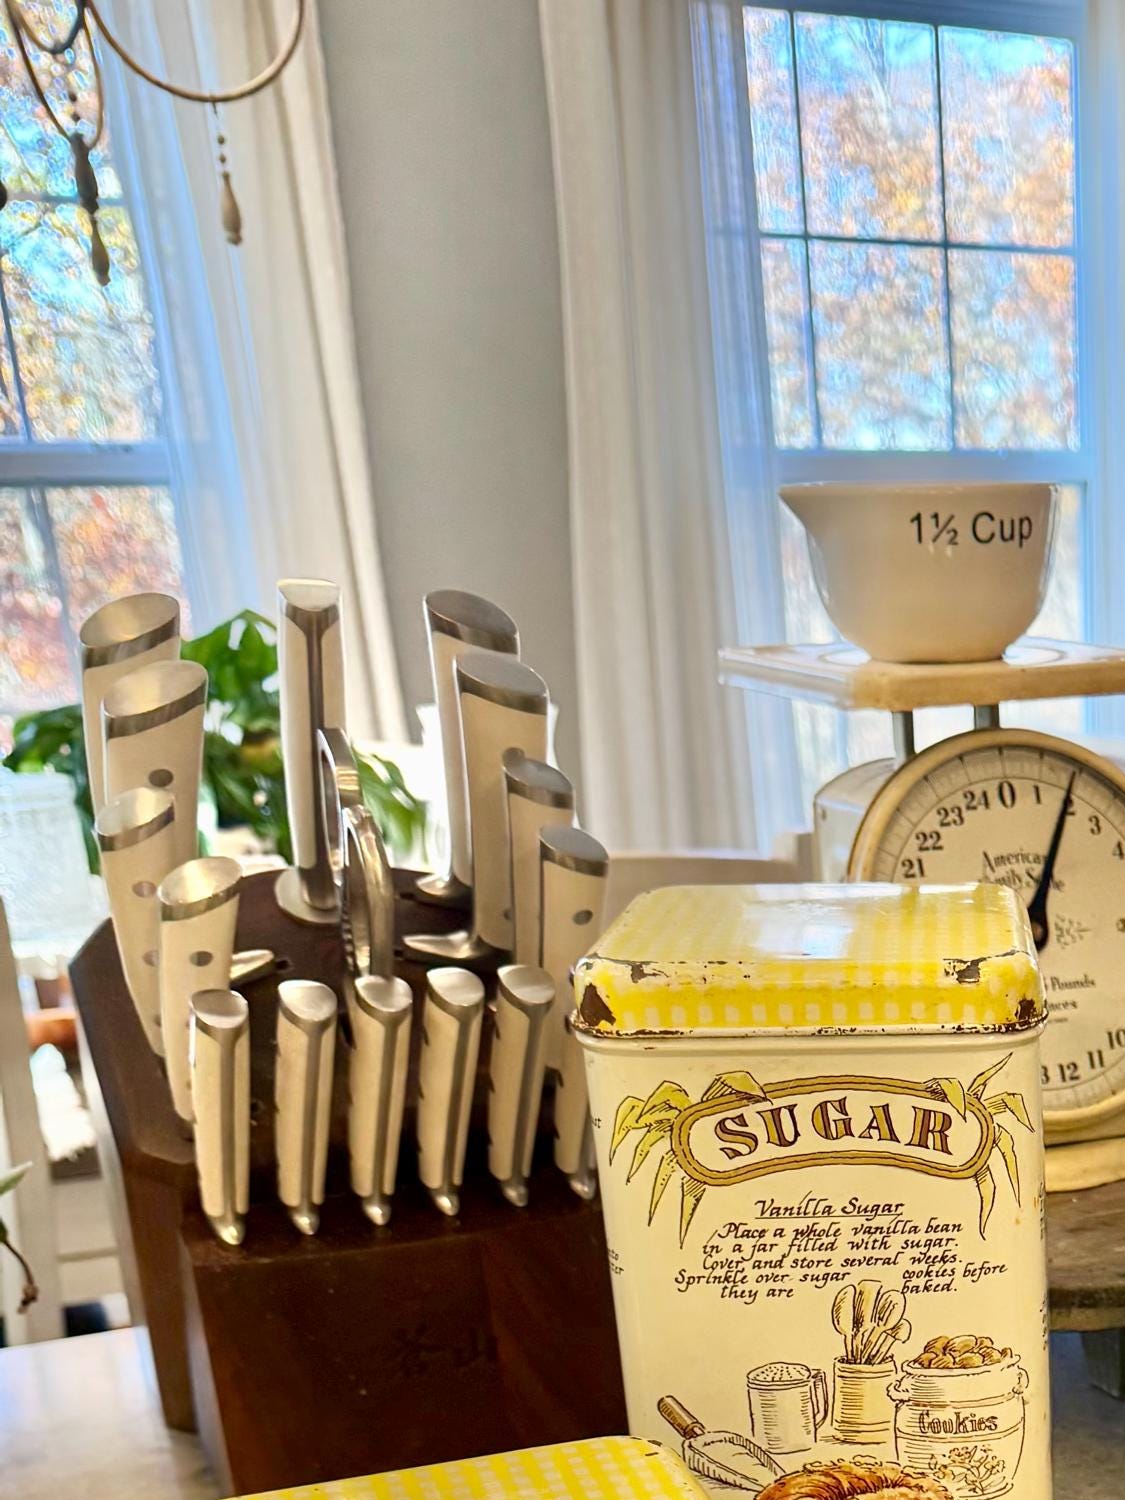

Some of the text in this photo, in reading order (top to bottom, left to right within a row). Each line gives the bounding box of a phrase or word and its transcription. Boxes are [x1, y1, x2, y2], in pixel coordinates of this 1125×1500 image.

[972, 511, 1033, 548] Cup
[963, 790, 990, 810] 24
[998, 780, 1016, 809] 0
[1033, 785, 1042, 804] 1
[936, 807, 964, 827] 23
[1089, 815, 1101, 835] 3
[915, 831, 944, 851] 22
[1112, 840, 1125, 860] 4
[901, 858, 927, 878] 21
[1087, 1050, 1104, 1069] 11
[1057, 1062, 1081, 1082] 12
[714, 1096, 955, 1161] SUGAR
[754, 1192, 905, 1221] Vanilla Sugar
[717, 1217, 963, 1239] Place a whole vanilla bean
[702, 1234, 959, 1261] in a jar filled with sugar.
[752, 1254, 785, 1270] and
[790, 1256, 833, 1269] store
[841, 1251, 904, 1267] several
[910, 1250, 963, 1266] weeks.
[674, 1261, 1008, 1292] Sprinkle over sugar cookies before
[721, 1278, 957, 1305] they are baked.
[918, 1409, 998, 1435] Cookies
